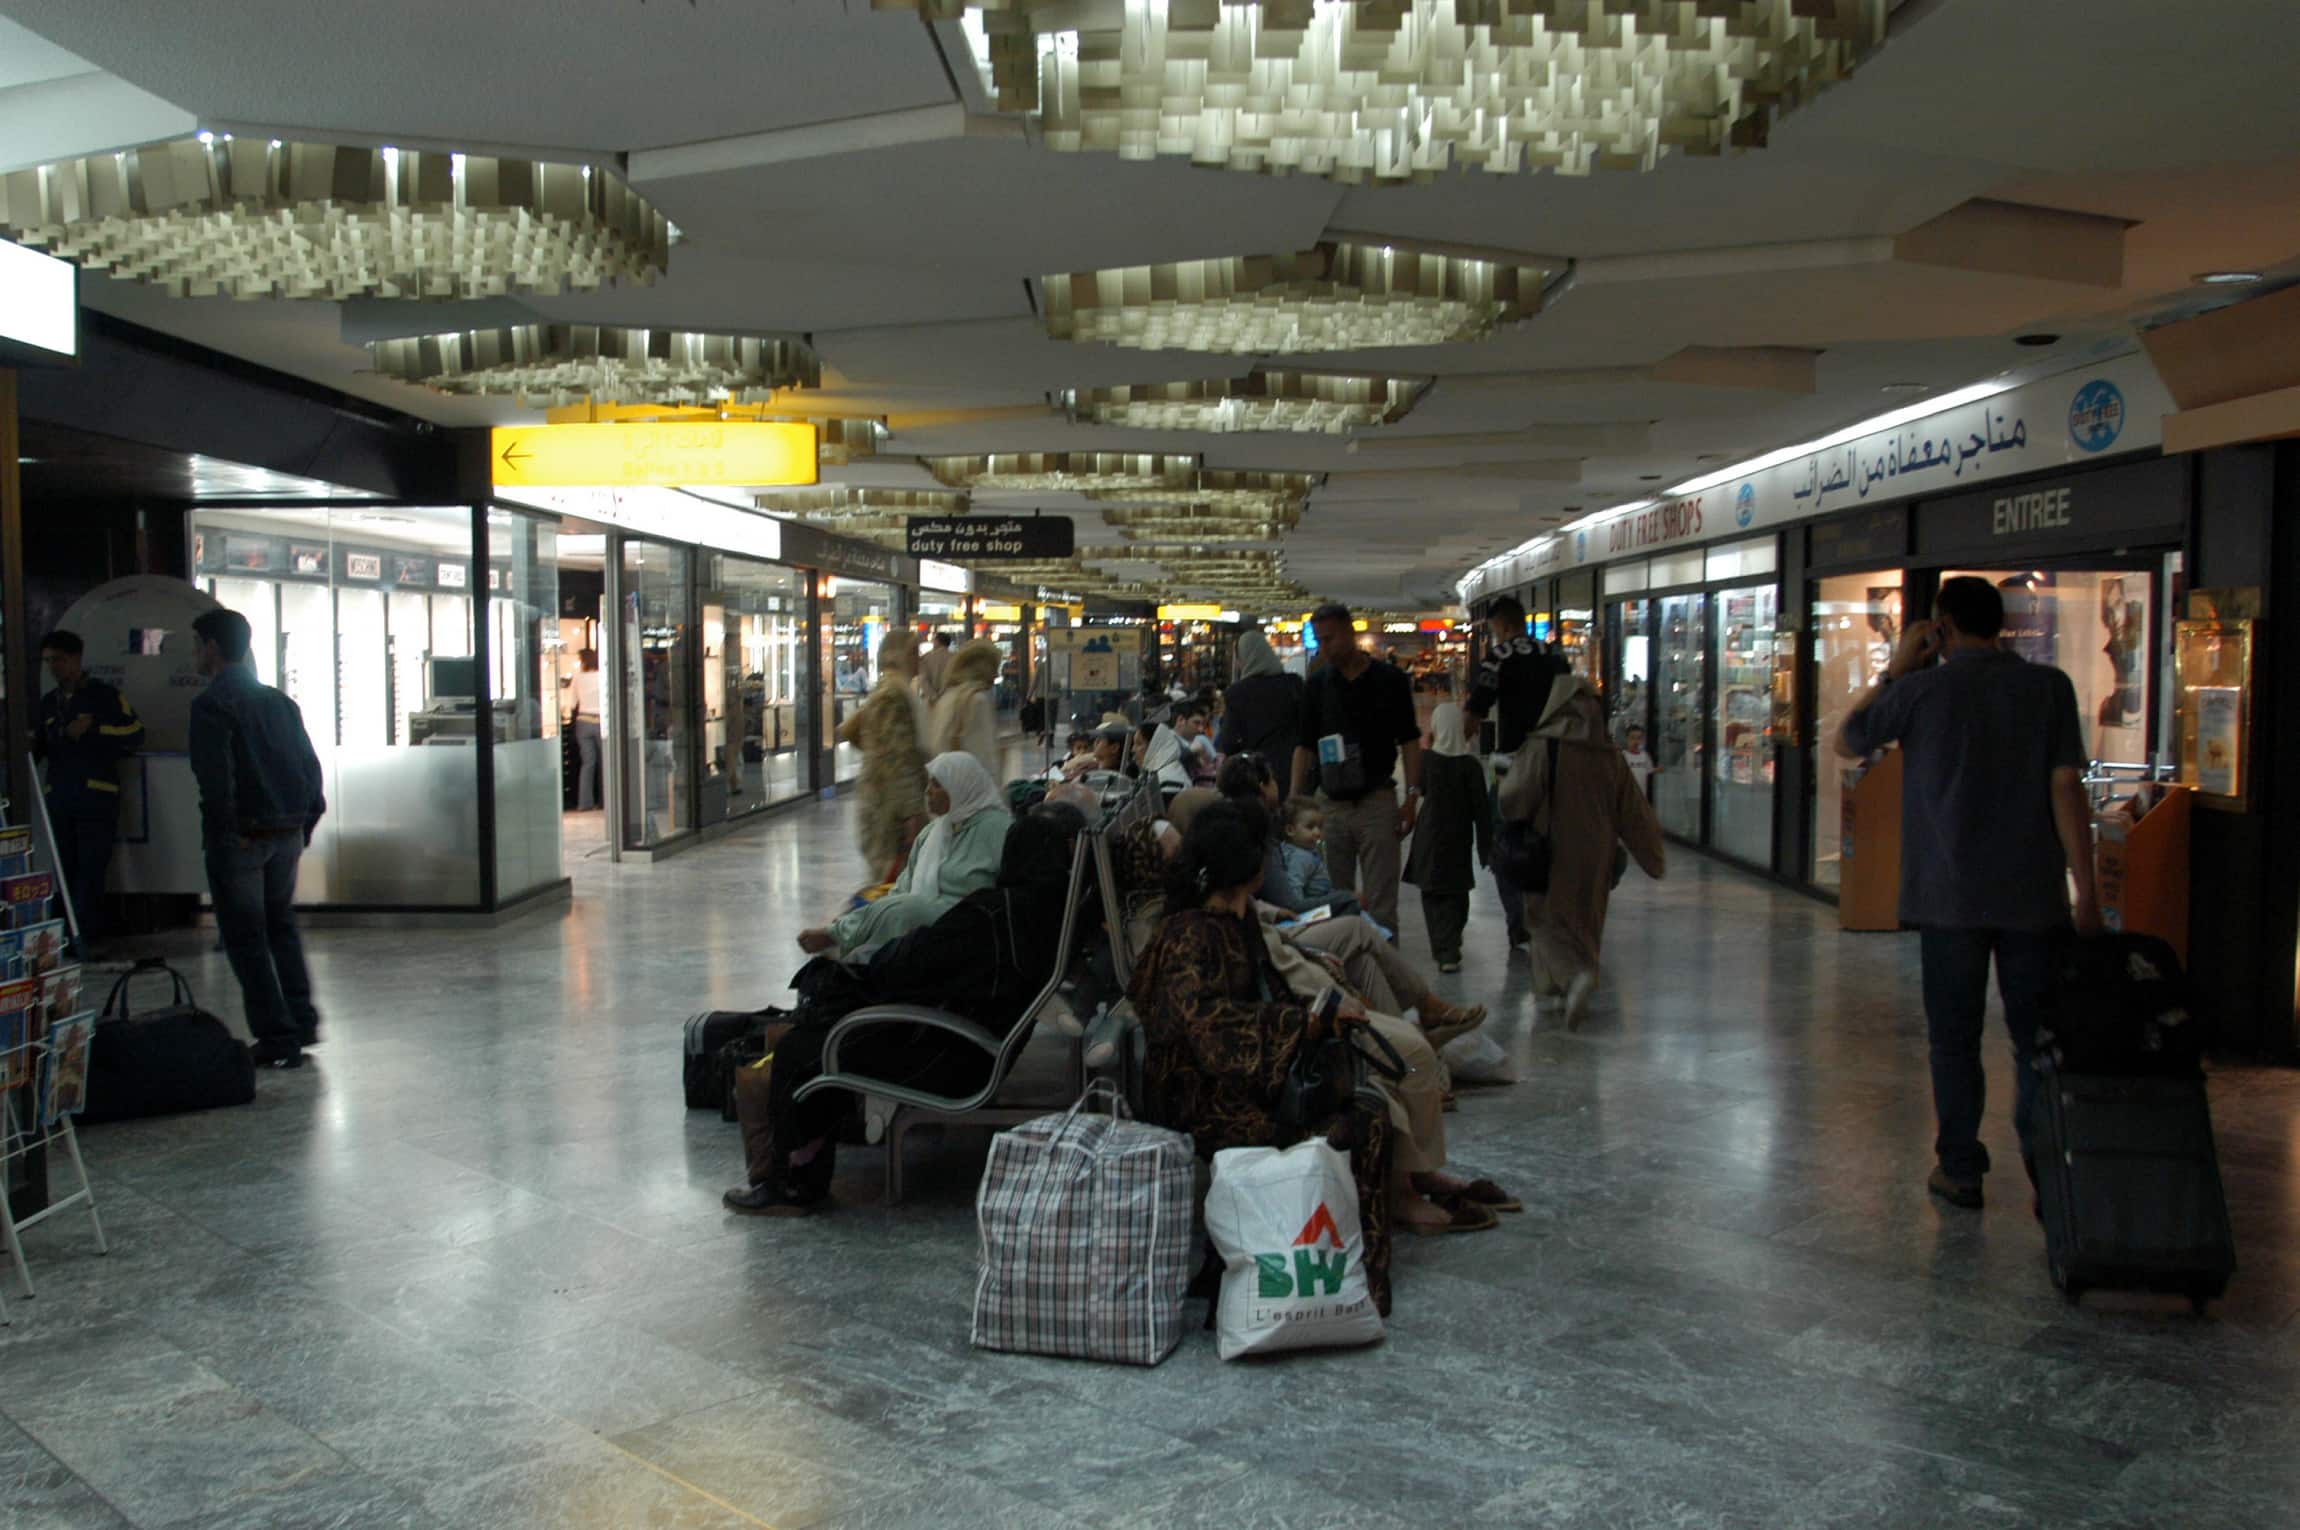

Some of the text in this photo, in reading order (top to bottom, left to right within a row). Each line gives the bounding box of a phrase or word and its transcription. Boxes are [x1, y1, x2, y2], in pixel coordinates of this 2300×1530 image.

[1793, 408, 2026, 509] متاجر معفاة من الضرائب
[1609, 497, 1703, 553] DUTY FREE SHOPS
[1993, 487, 2072, 535] ENTREE
[911, 538, 1023, 555] duty free shop
[1255, 1248, 1348, 1298] BHV
[1256, 1305, 1325, 1322] L'esprit
